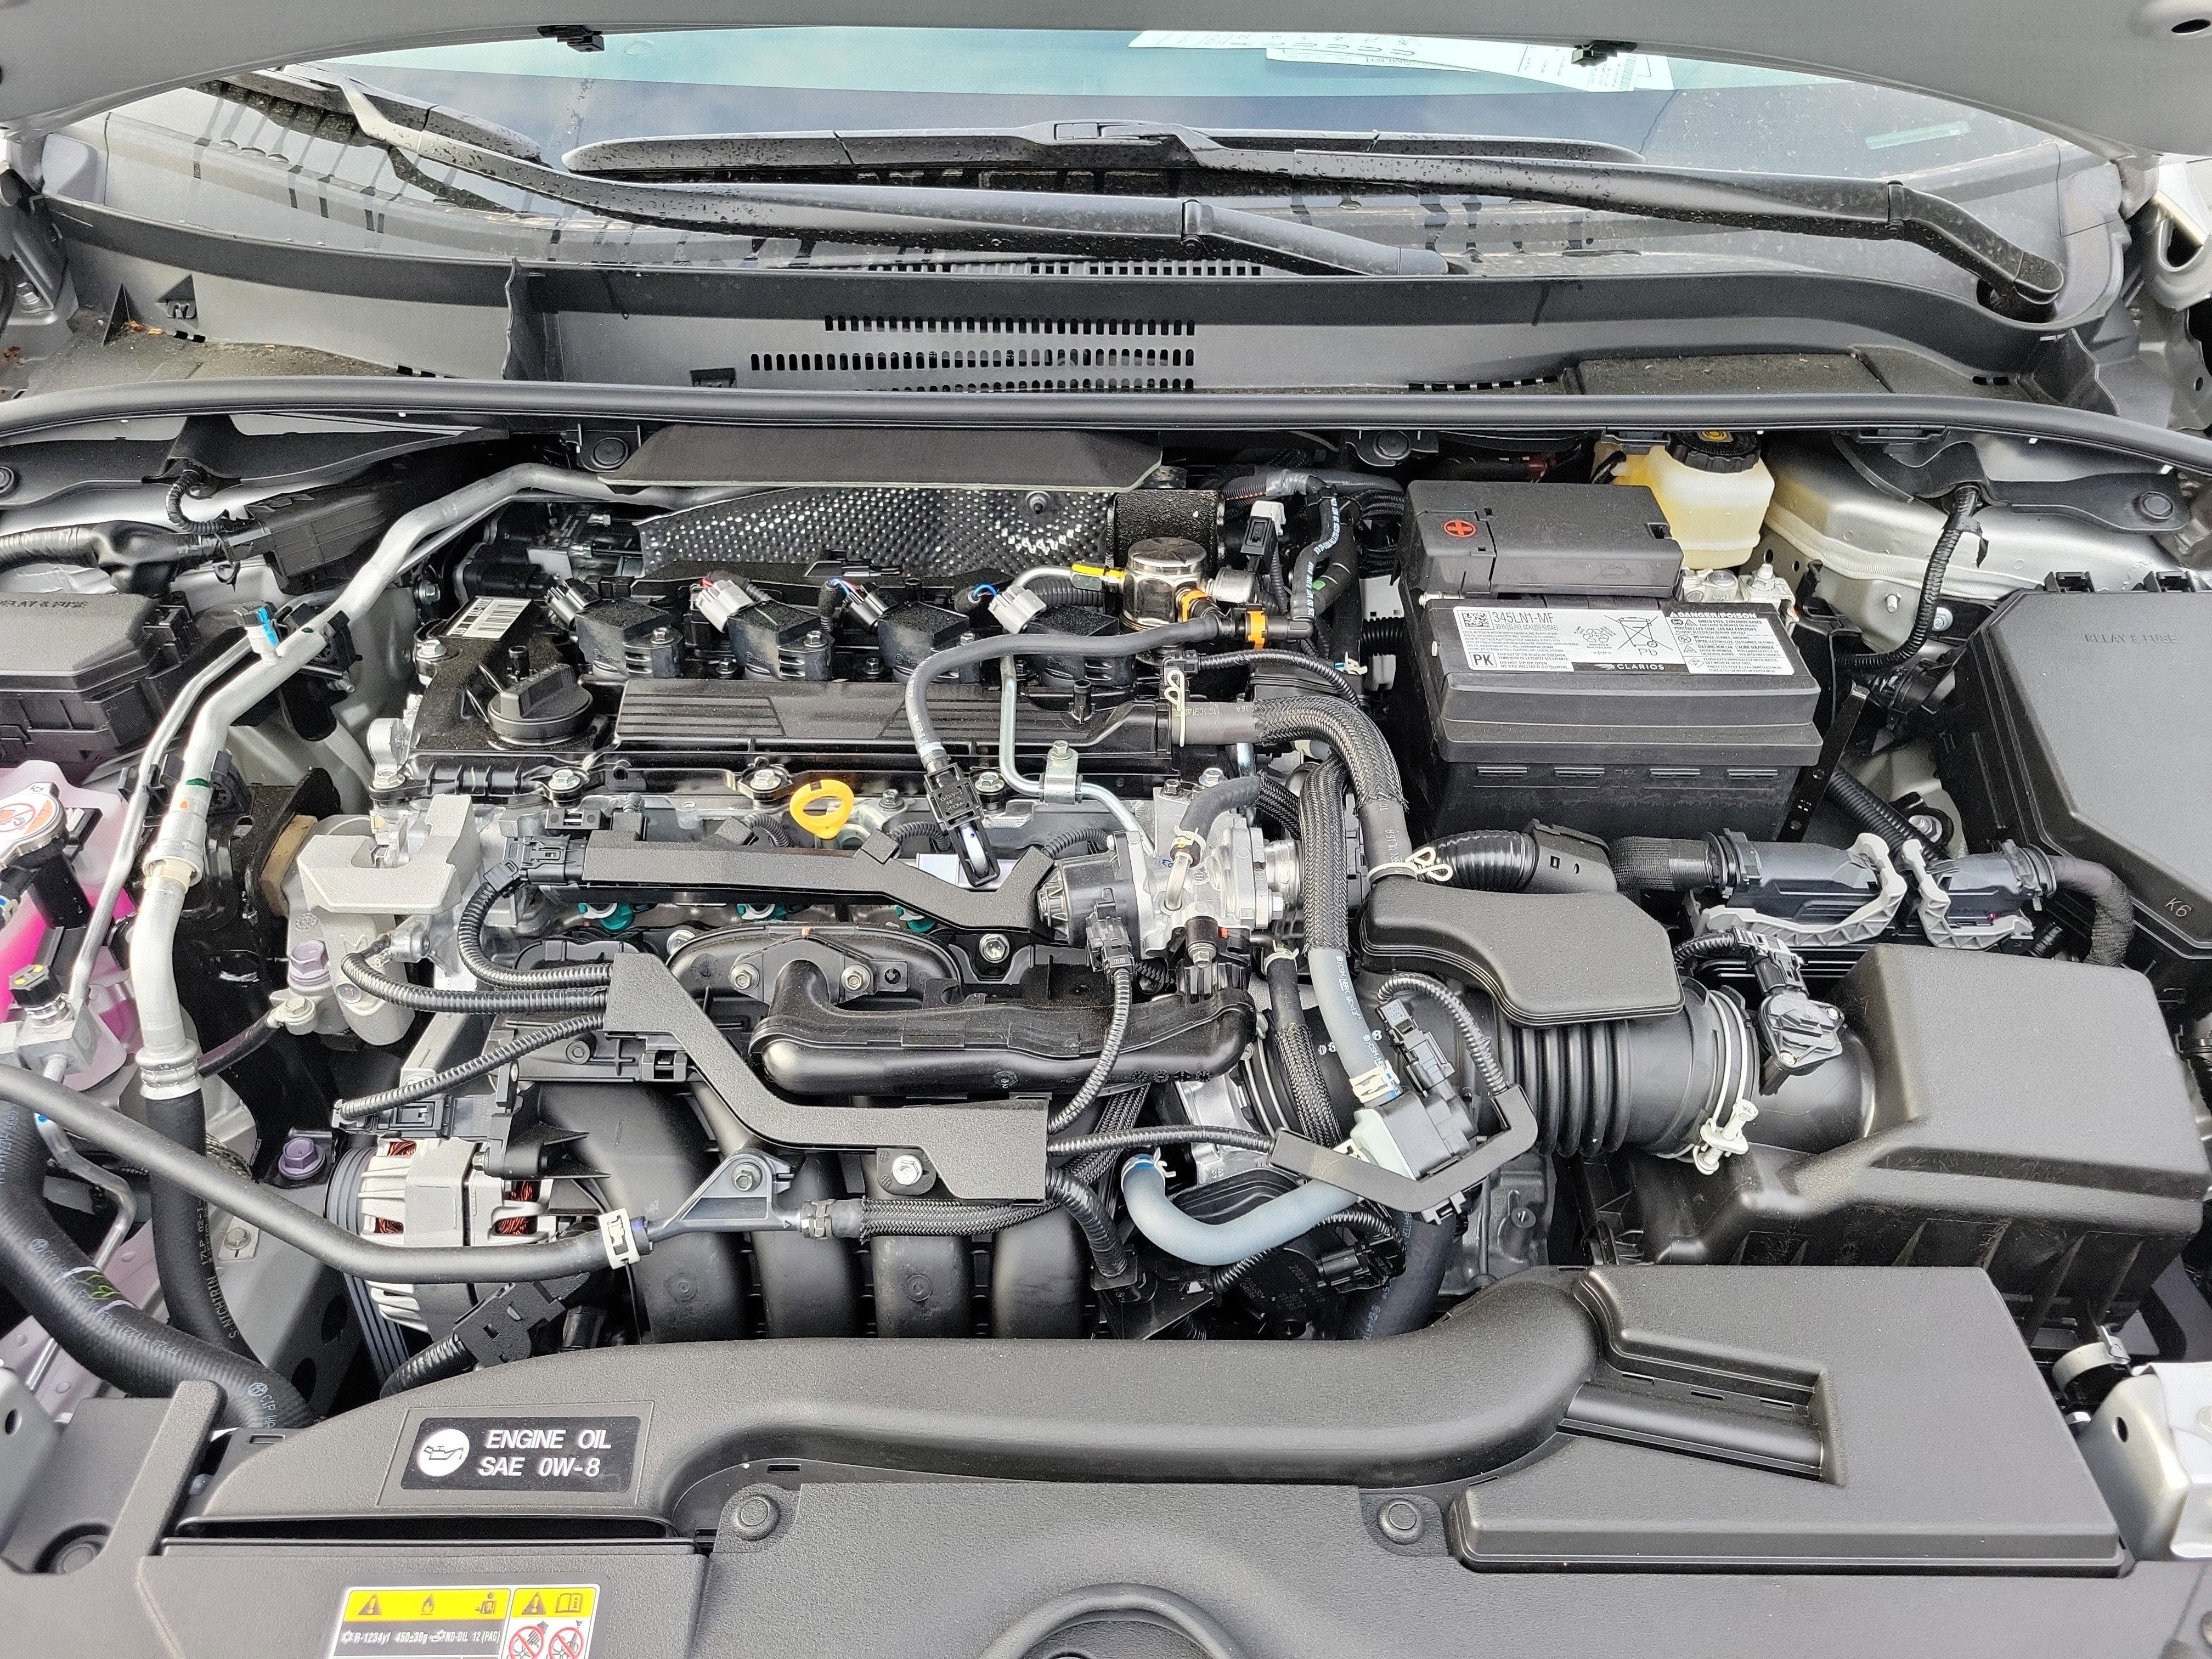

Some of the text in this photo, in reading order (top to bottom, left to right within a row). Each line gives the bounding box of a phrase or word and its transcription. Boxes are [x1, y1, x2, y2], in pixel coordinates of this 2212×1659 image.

[1492, 612, 1554, 623] 345LN1-MF
[2084, 634, 2125, 642] RELAY
[1638, 648, 1658, 656] Pb
[1472, 654, 1494, 665] PK
[2164, 897, 2192, 917] K6
[486, 1429, 612, 1449] ENGINE OIL
[477, 1456, 601, 1477] SAE 0W-8
[354, 1630, 501, 1644] R-1234yf 450±30g ND-OIL 12 (PAG)
